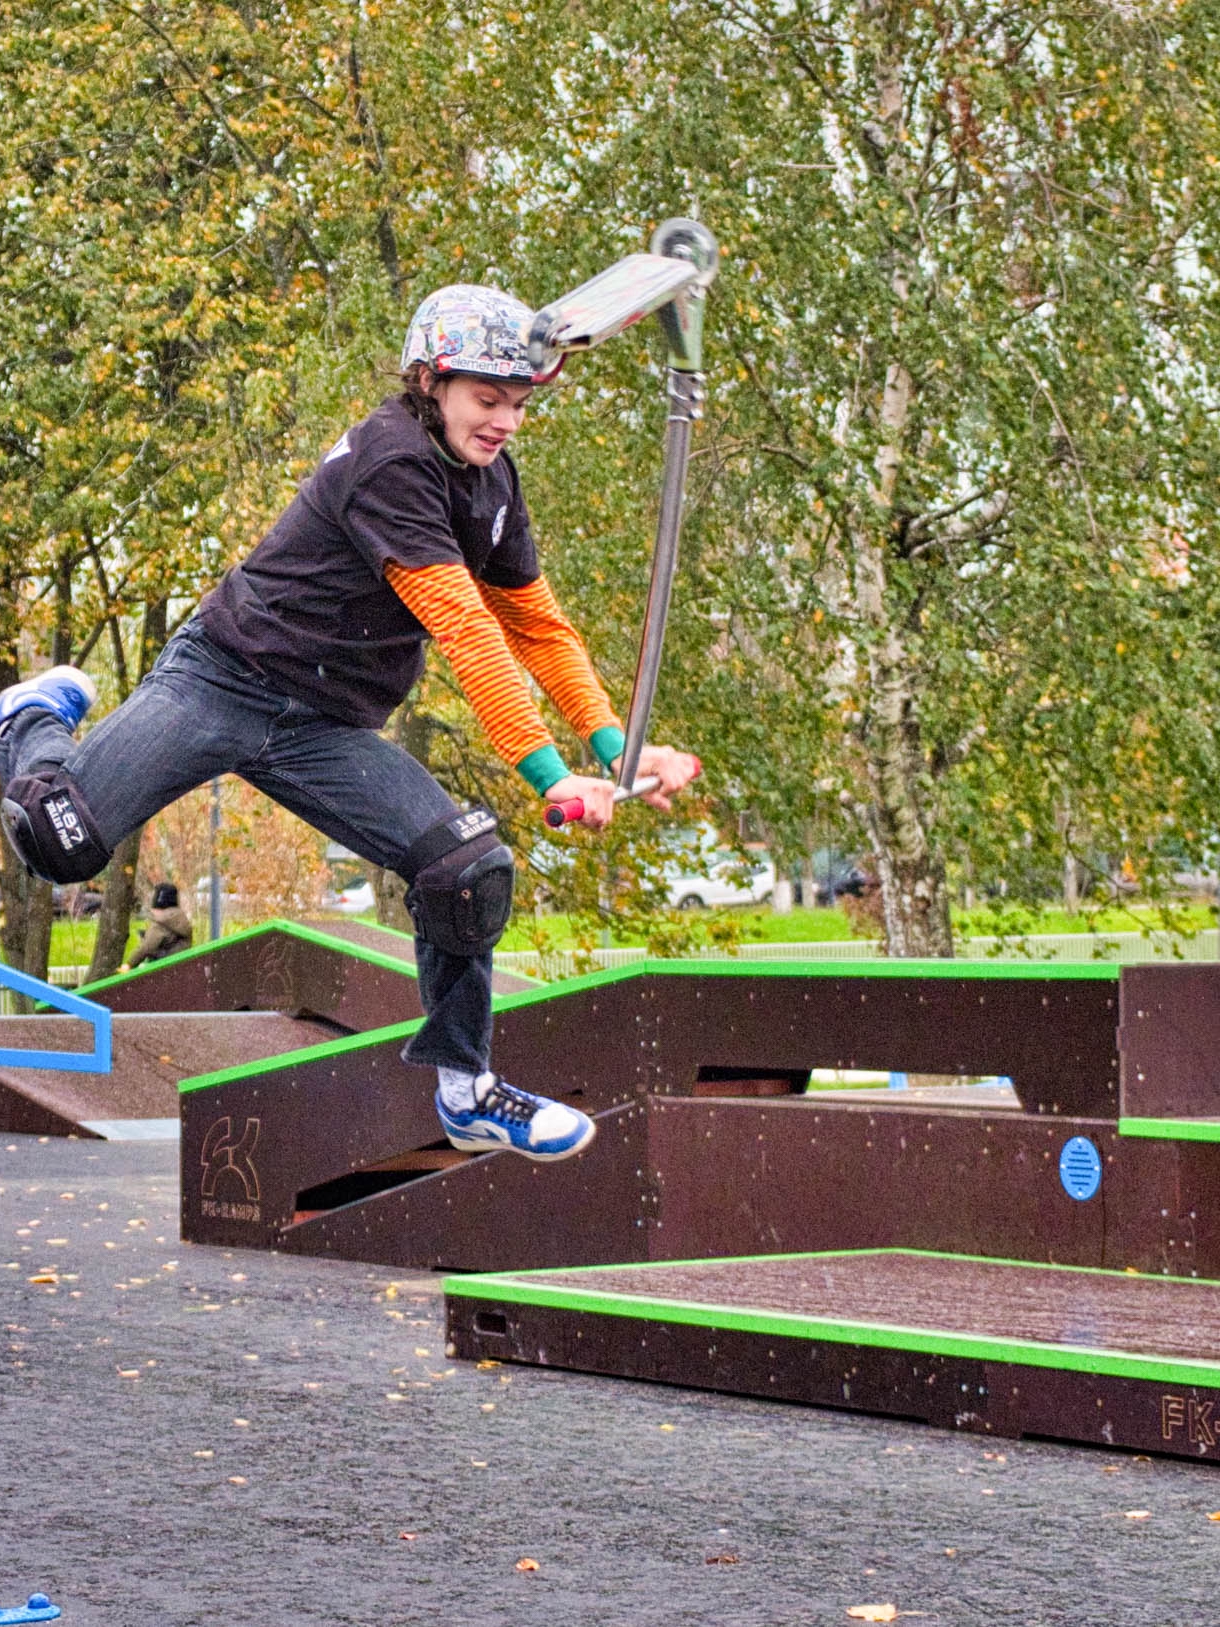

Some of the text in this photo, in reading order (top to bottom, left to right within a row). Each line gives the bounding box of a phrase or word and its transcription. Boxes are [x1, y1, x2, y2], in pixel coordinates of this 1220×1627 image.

[450, 355, 498, 373] element
[56, 796, 84, 842] 187
[455, 810, 488, 831] 187
